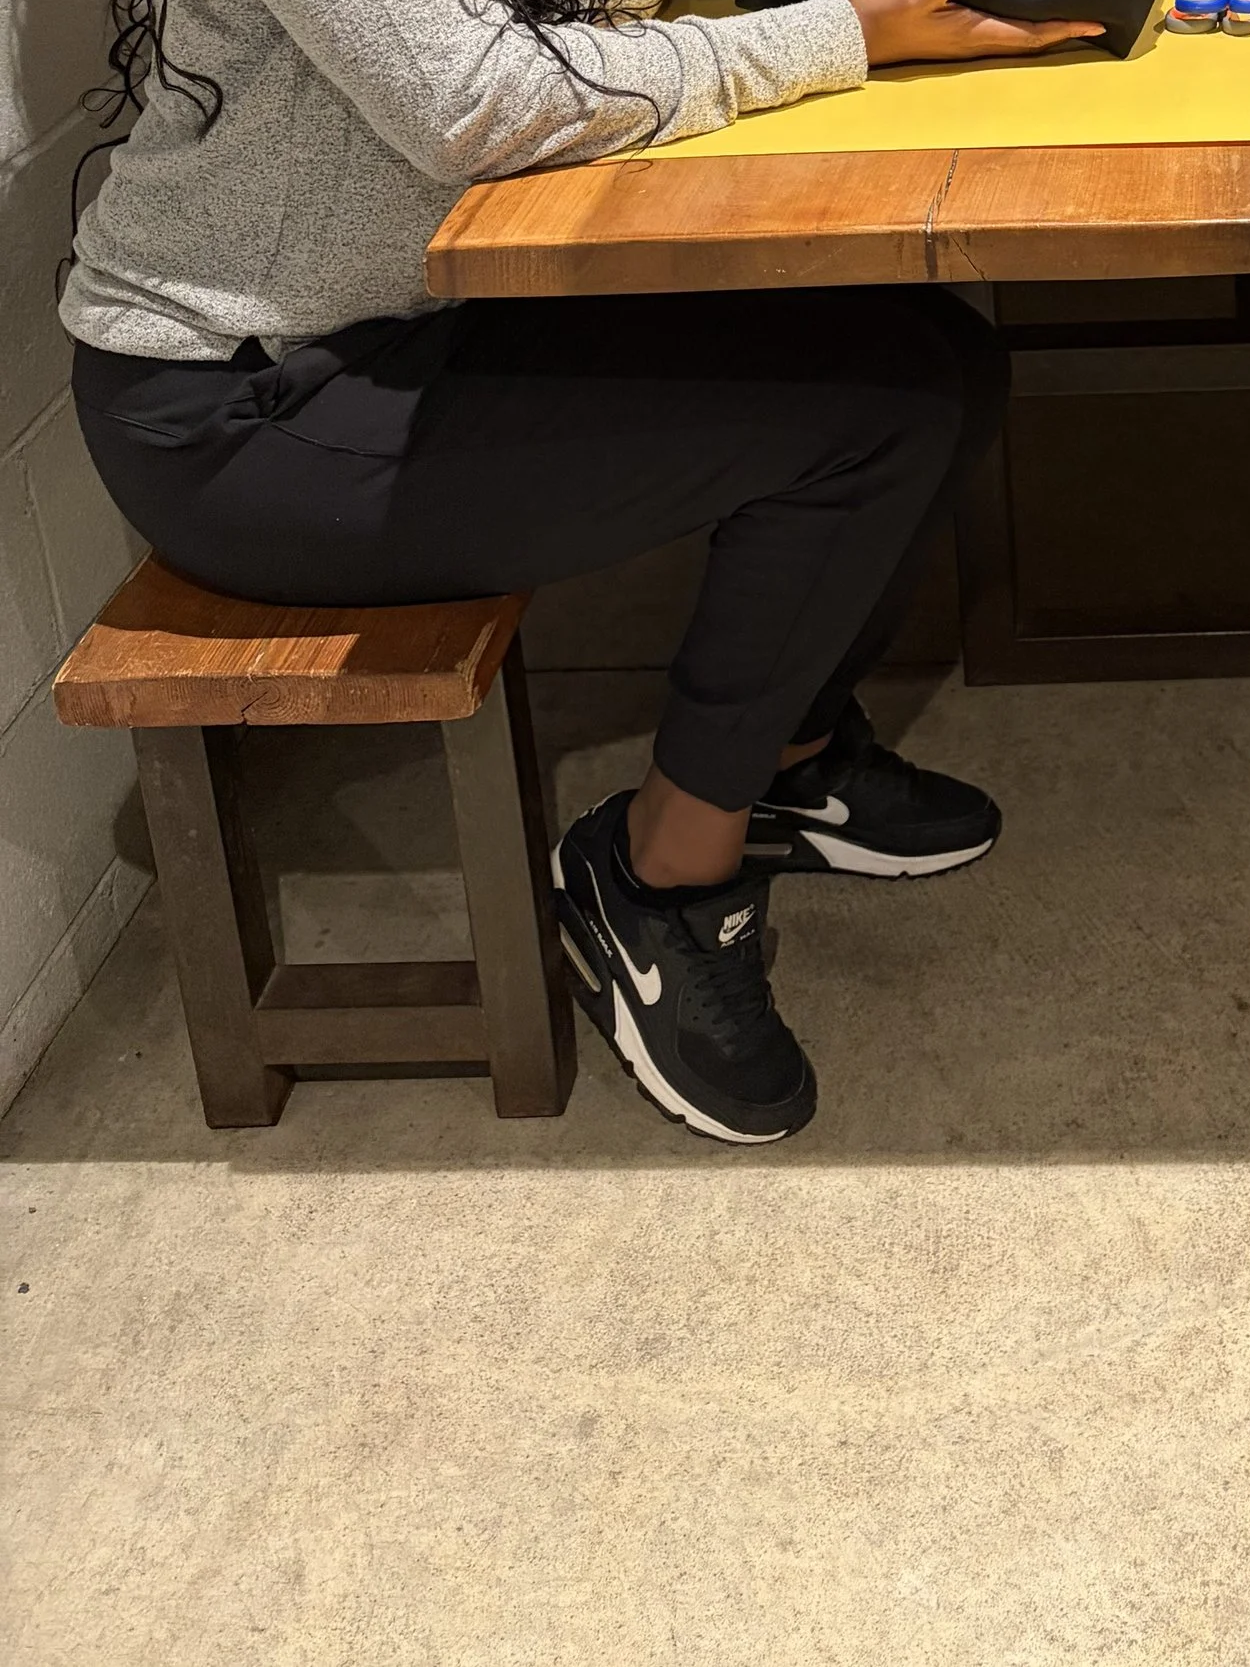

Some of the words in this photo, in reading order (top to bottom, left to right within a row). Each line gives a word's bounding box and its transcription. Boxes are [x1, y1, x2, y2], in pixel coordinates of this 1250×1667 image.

[723, 907, 750, 930] NIKE
[597, 932, 613, 959] MAX
[740, 929, 756, 941] MAX
